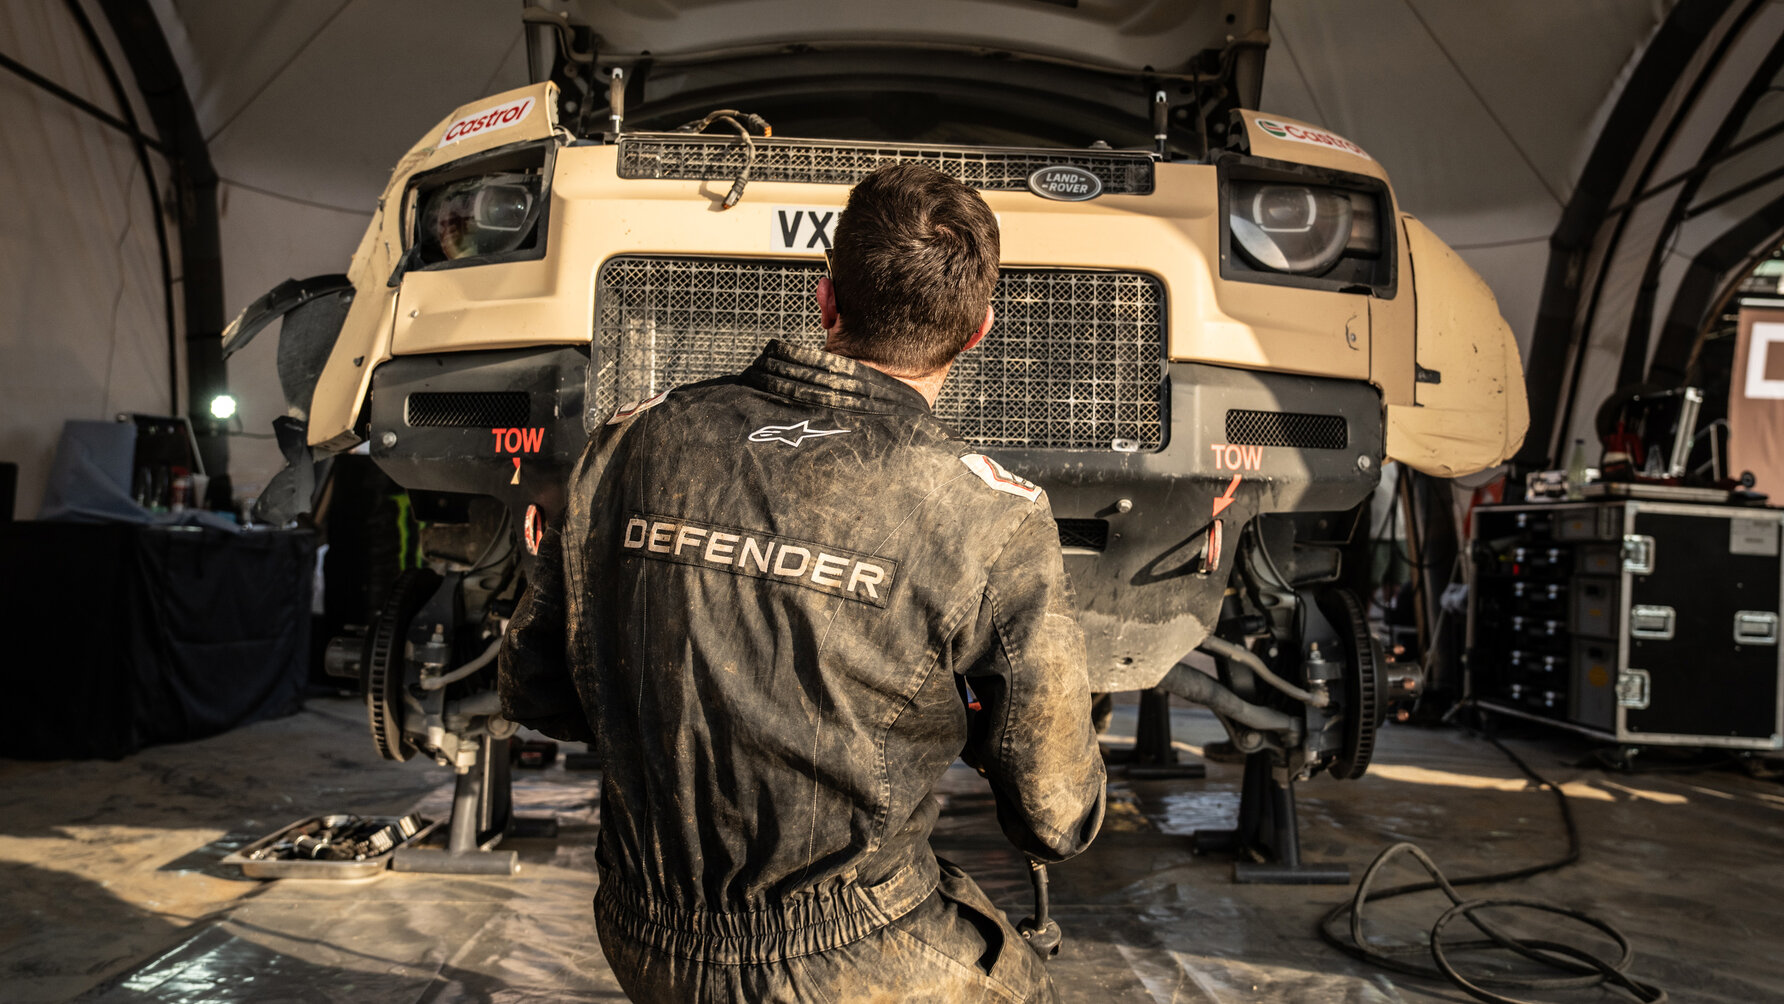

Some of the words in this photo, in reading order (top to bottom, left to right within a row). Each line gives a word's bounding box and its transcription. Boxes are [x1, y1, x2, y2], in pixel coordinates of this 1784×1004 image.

[445, 100, 530, 141] Castrol
[778, 210, 843, 248] VX
[491, 427, 545, 454] TOW
[1210, 444, 1264, 471] TOW
[623, 518, 886, 599] DEFENDER
